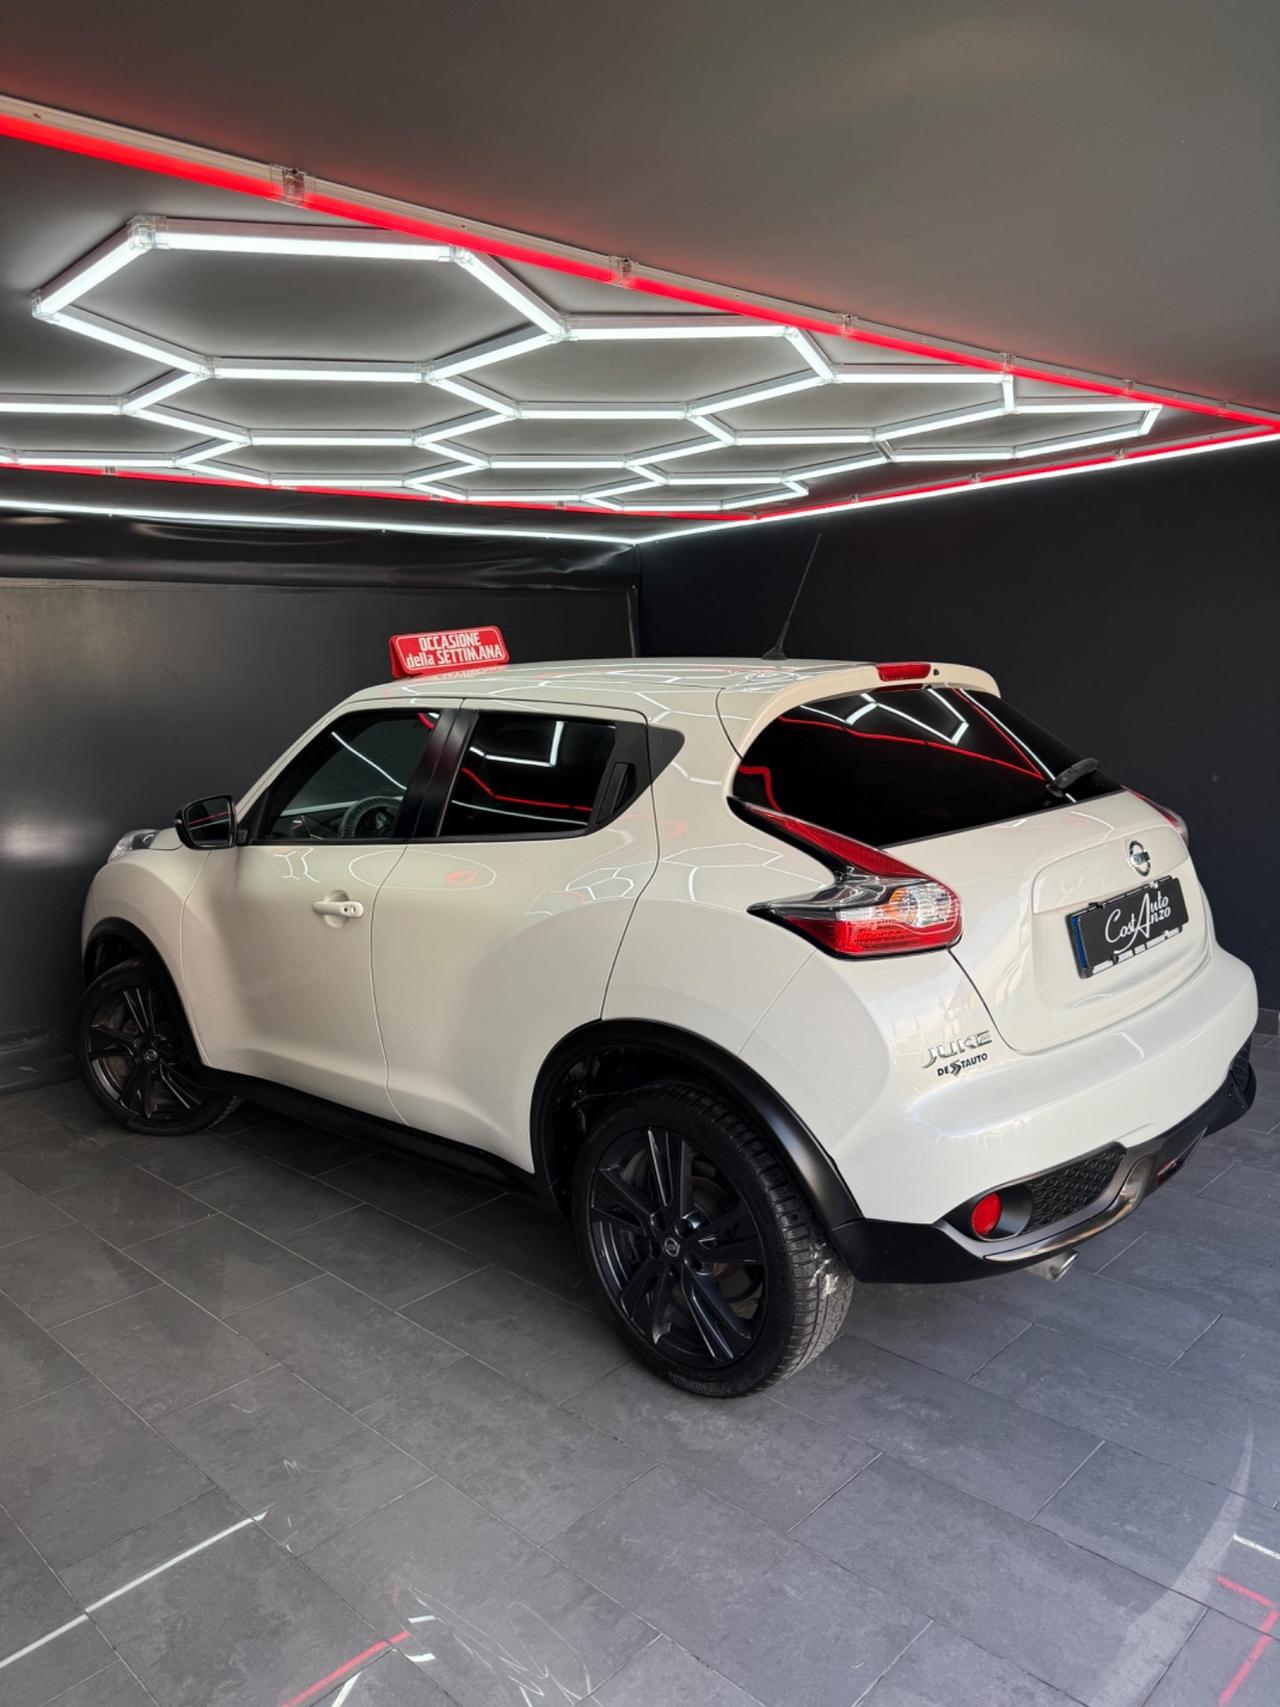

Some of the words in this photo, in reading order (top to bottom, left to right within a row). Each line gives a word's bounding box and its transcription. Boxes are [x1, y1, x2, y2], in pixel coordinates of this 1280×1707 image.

[418, 632, 481, 652] OCCASIONE
[405, 651, 435, 668] della
[436, 643, 503, 665] SETTIMANA
[921, 1029, 993, 1069] JUKE
